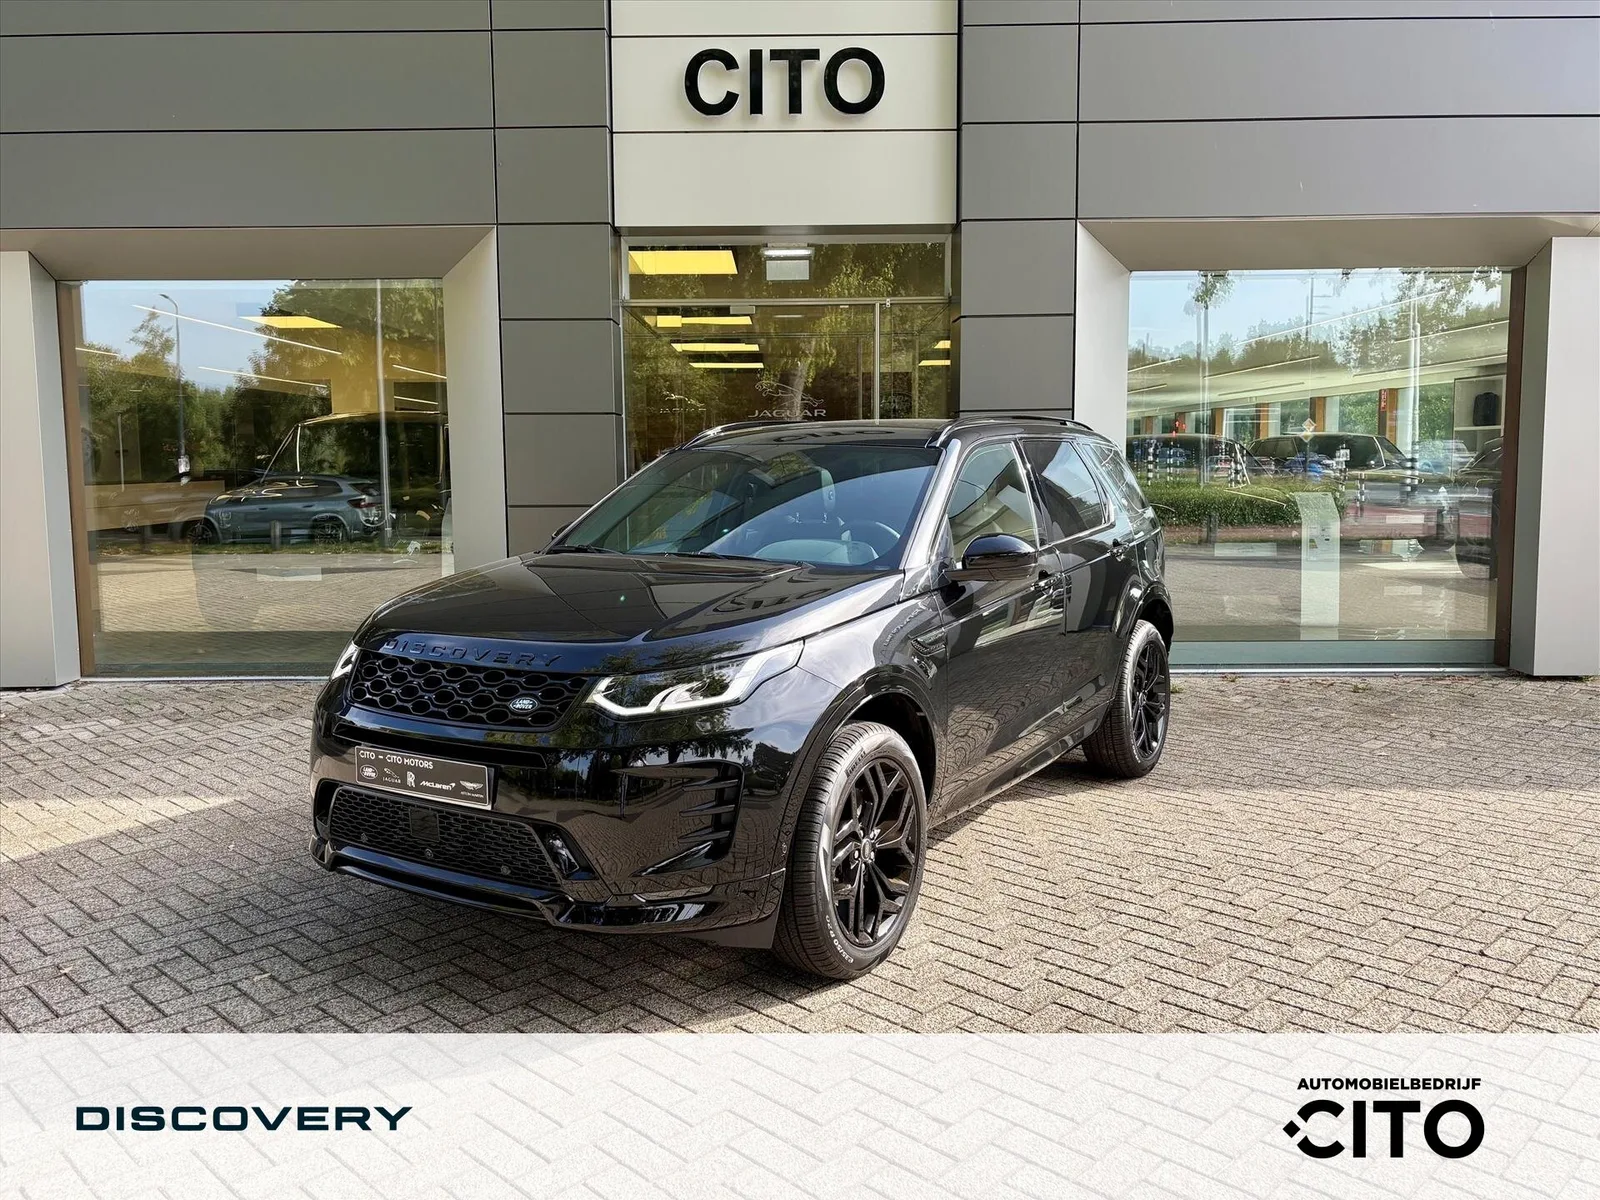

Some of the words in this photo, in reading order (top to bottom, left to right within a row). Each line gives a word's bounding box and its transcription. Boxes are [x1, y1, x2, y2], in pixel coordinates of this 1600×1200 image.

[684, 47, 886, 116] CITO
[748, 409, 827, 418] JAGUAR
[382, 638, 562, 668] DISCOVERY
[359, 750, 376, 760] CITO
[386, 754, 402, 764] CITO
[403, 757, 434, 770] MOTORS
[420, 780, 452, 791] McLaren
